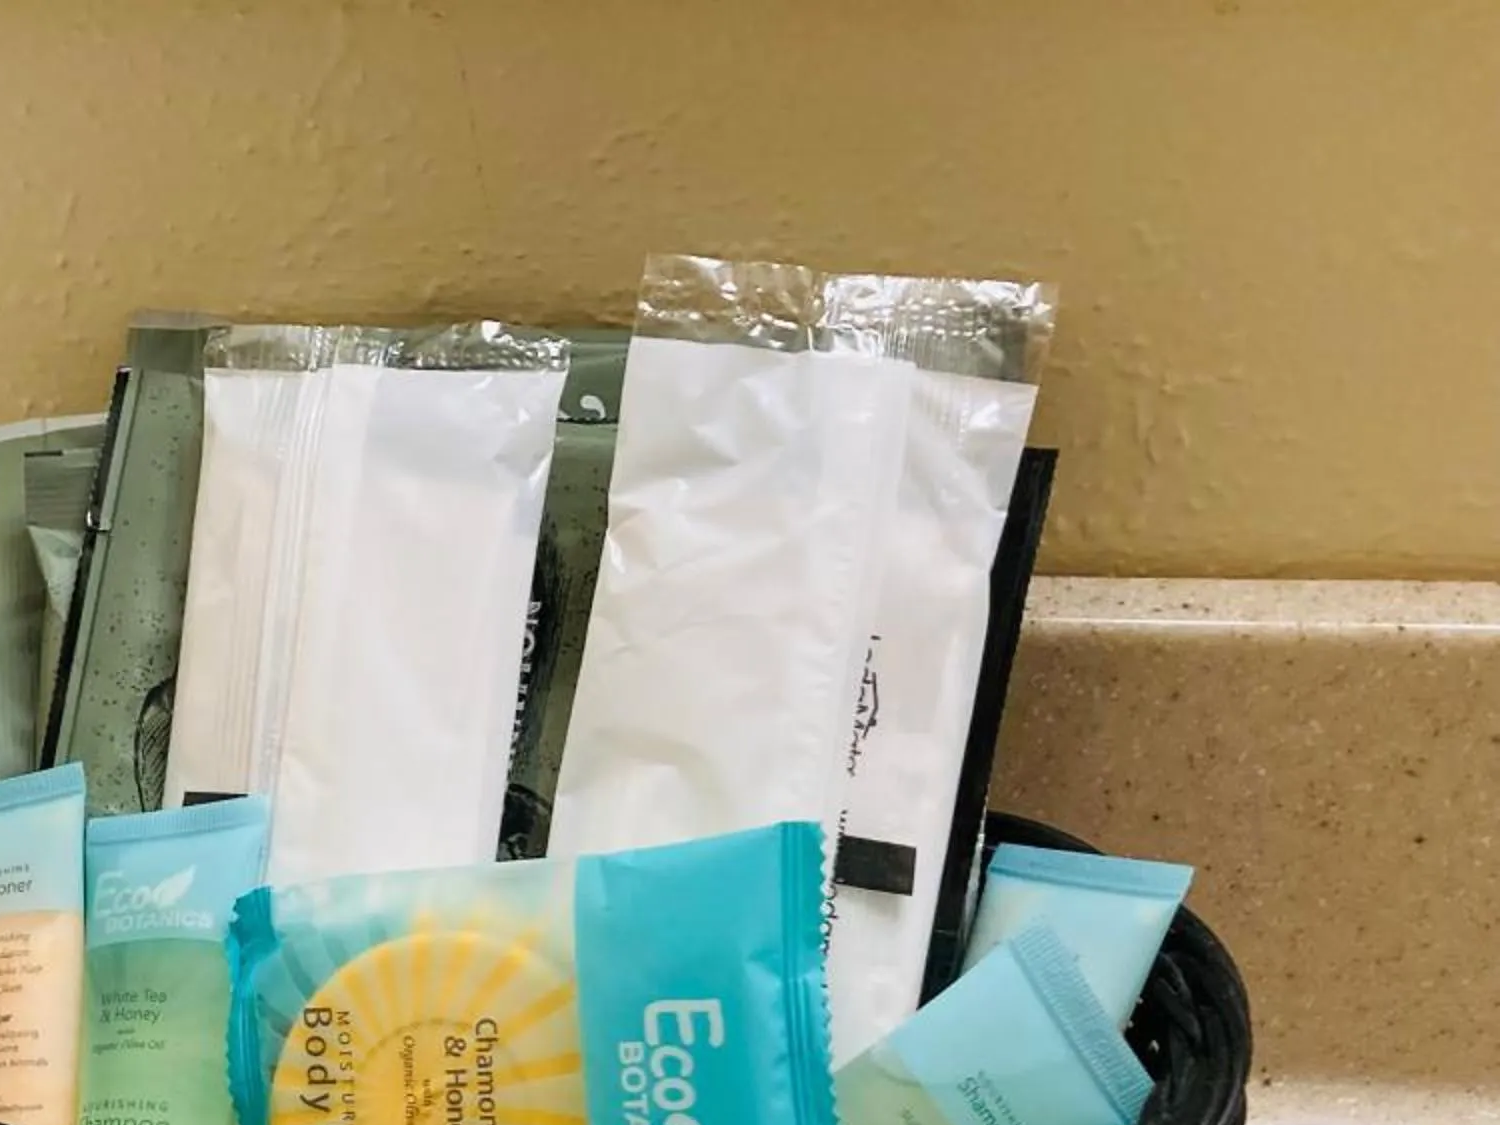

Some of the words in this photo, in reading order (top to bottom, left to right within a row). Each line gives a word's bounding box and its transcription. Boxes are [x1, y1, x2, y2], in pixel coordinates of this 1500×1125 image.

[101, 990, 139, 1005] White
[145, 988, 168, 1004] Tea
[100, 1009, 111, 1023] &
[115, 1006, 161, 1026] Honey
[443, 1035, 467, 1058] &
[300, 1006, 337, 1114] Body
